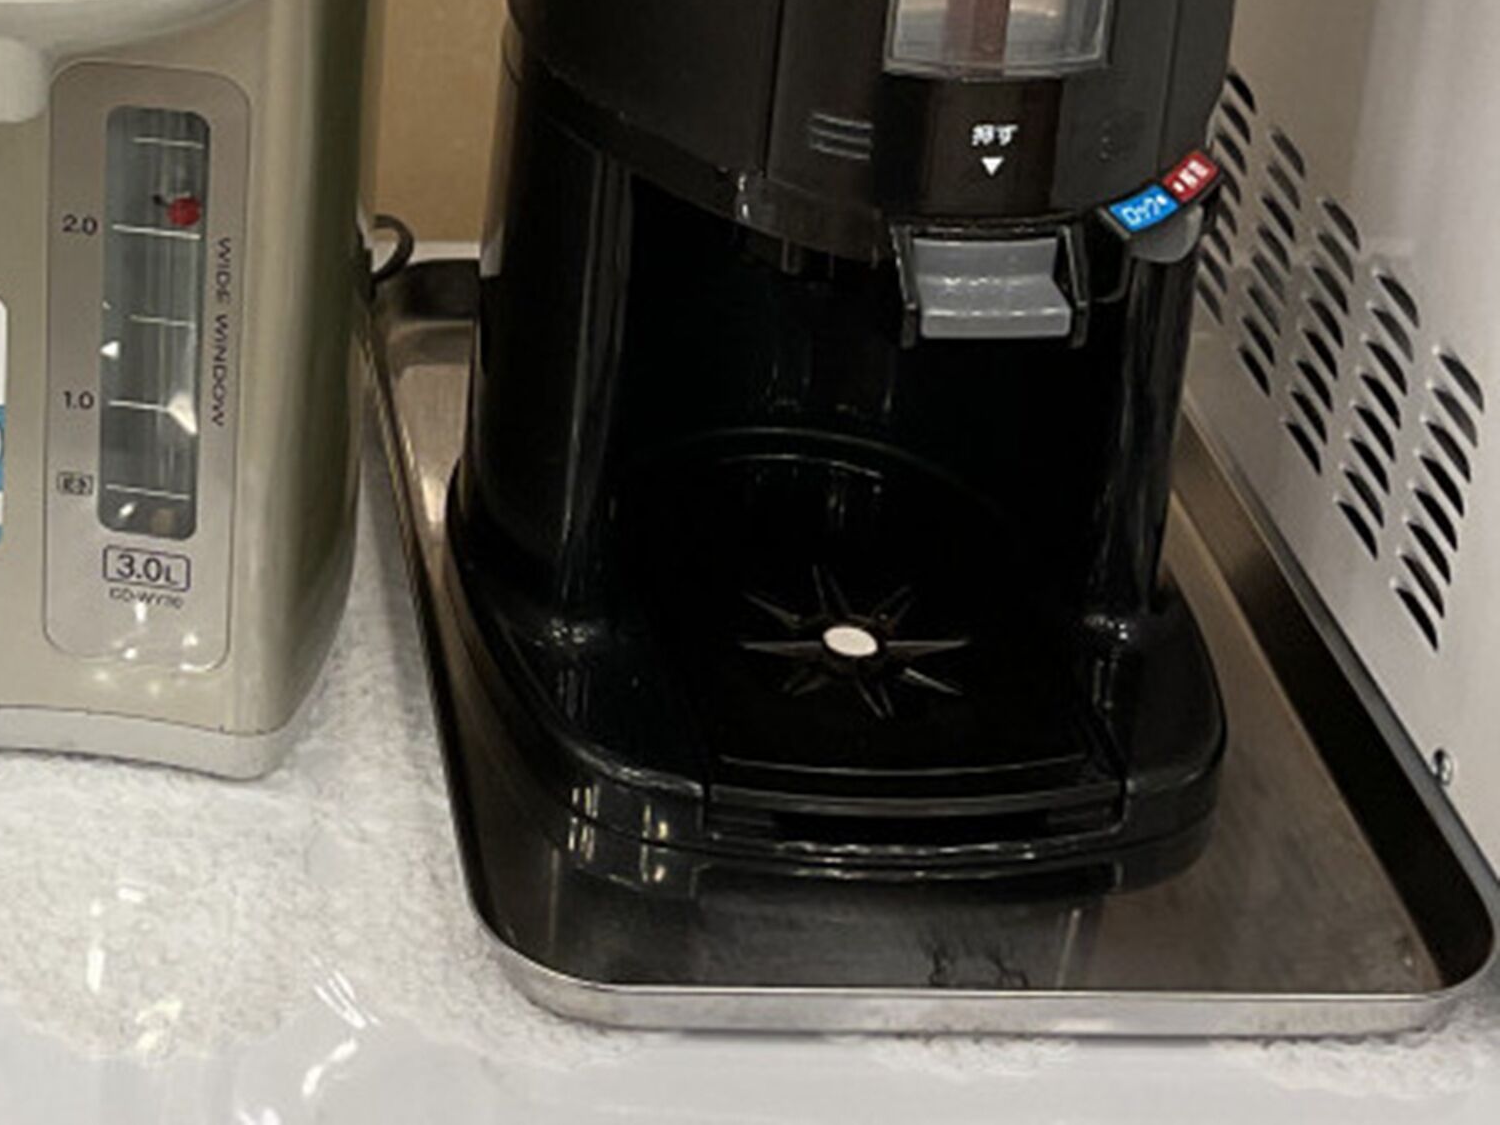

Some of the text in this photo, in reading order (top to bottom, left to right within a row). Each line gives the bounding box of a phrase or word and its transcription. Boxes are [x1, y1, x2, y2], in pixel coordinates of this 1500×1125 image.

[62, 214, 98, 235] 2.0
[211, 238, 231, 426] WIDE WINDOW
[63, 390, 94, 409] 1.0
[115, 553, 180, 586] 3.0L
